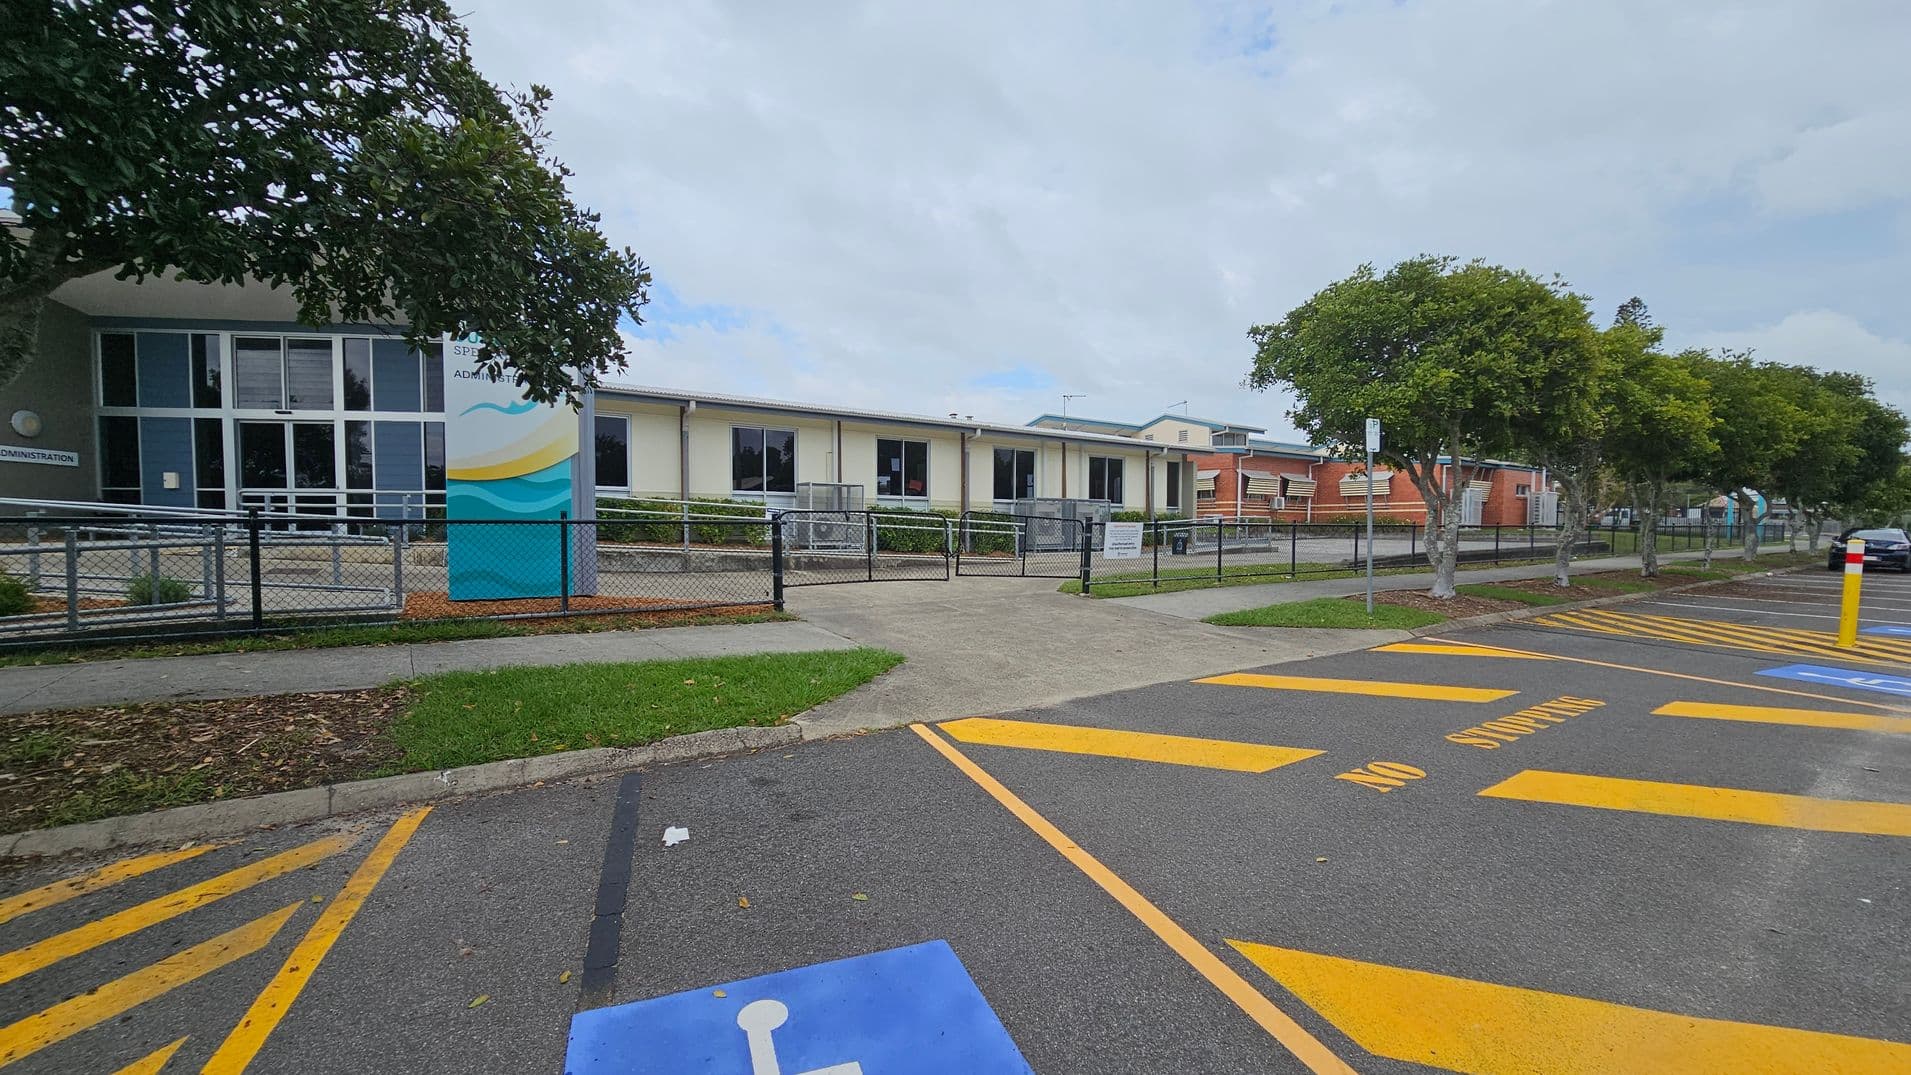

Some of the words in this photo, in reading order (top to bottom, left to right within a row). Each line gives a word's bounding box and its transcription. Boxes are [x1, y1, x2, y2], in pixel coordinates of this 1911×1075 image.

[0, 449, 74, 463] DMINISTRATION
[1334, 761, 1427, 793] NO
[1444, 695, 1607, 750] STOPPING
